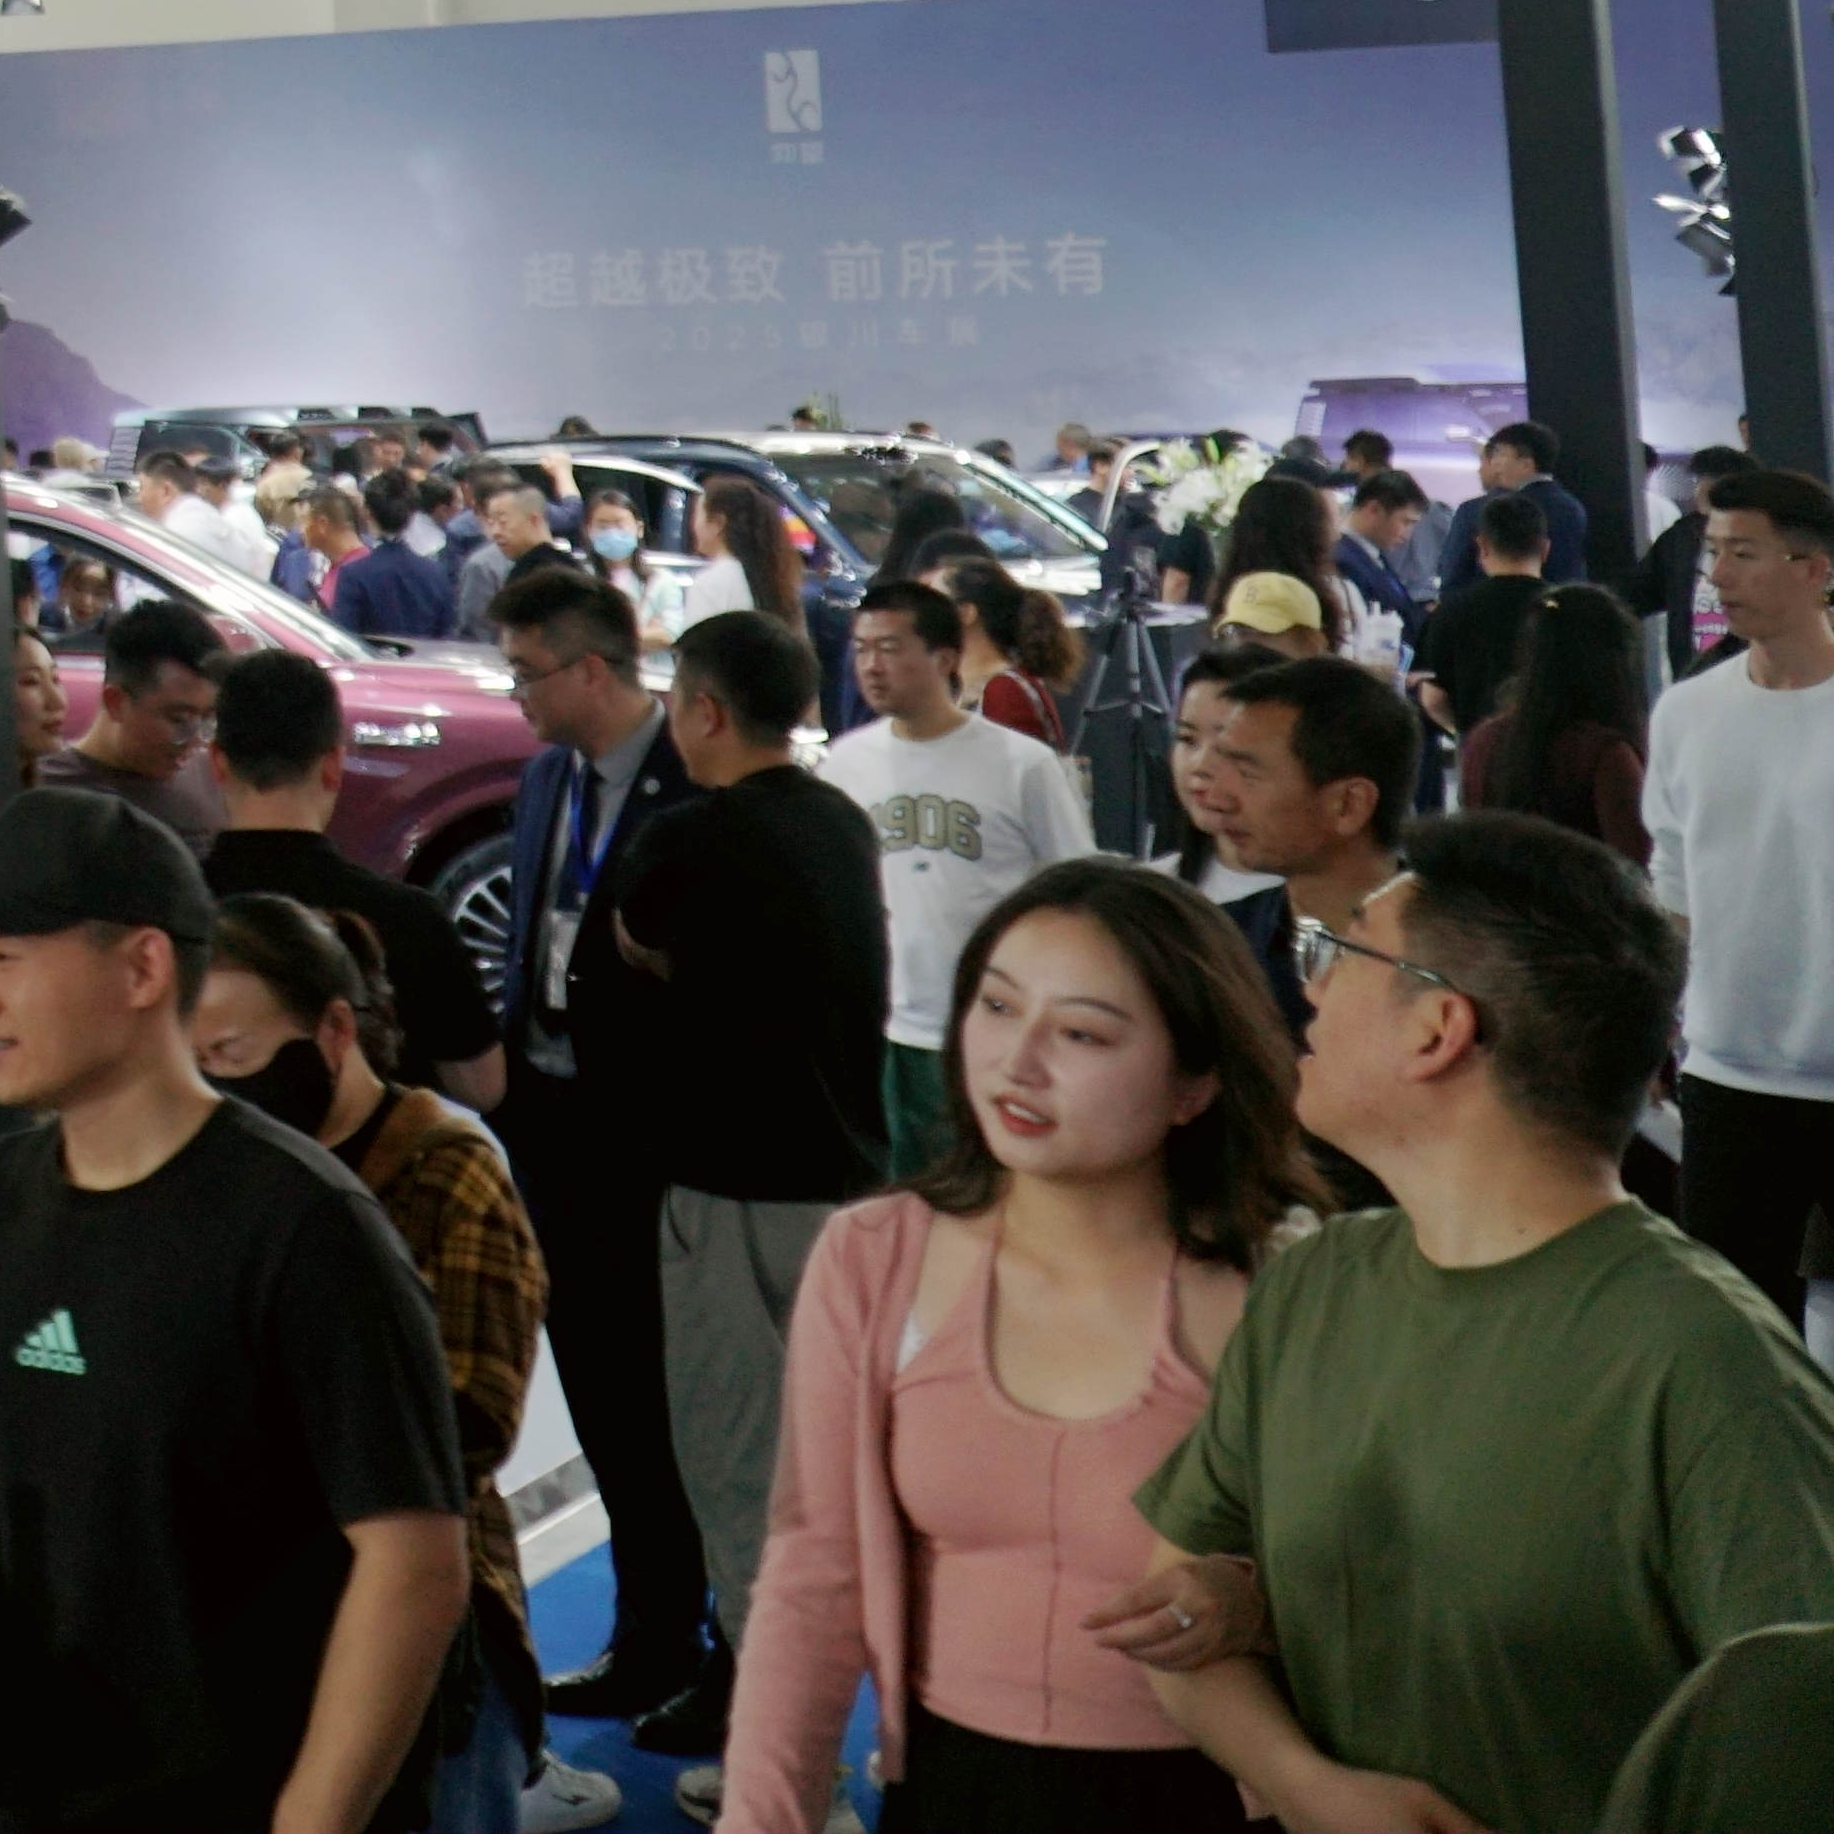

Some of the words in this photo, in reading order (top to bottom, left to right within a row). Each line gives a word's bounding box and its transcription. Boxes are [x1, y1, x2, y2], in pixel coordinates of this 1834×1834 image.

[522, 245, 785, 311] 超越极致
[823, 231, 1108, 302] 前所未有
[15, 1345, 87, 1376] adidas
